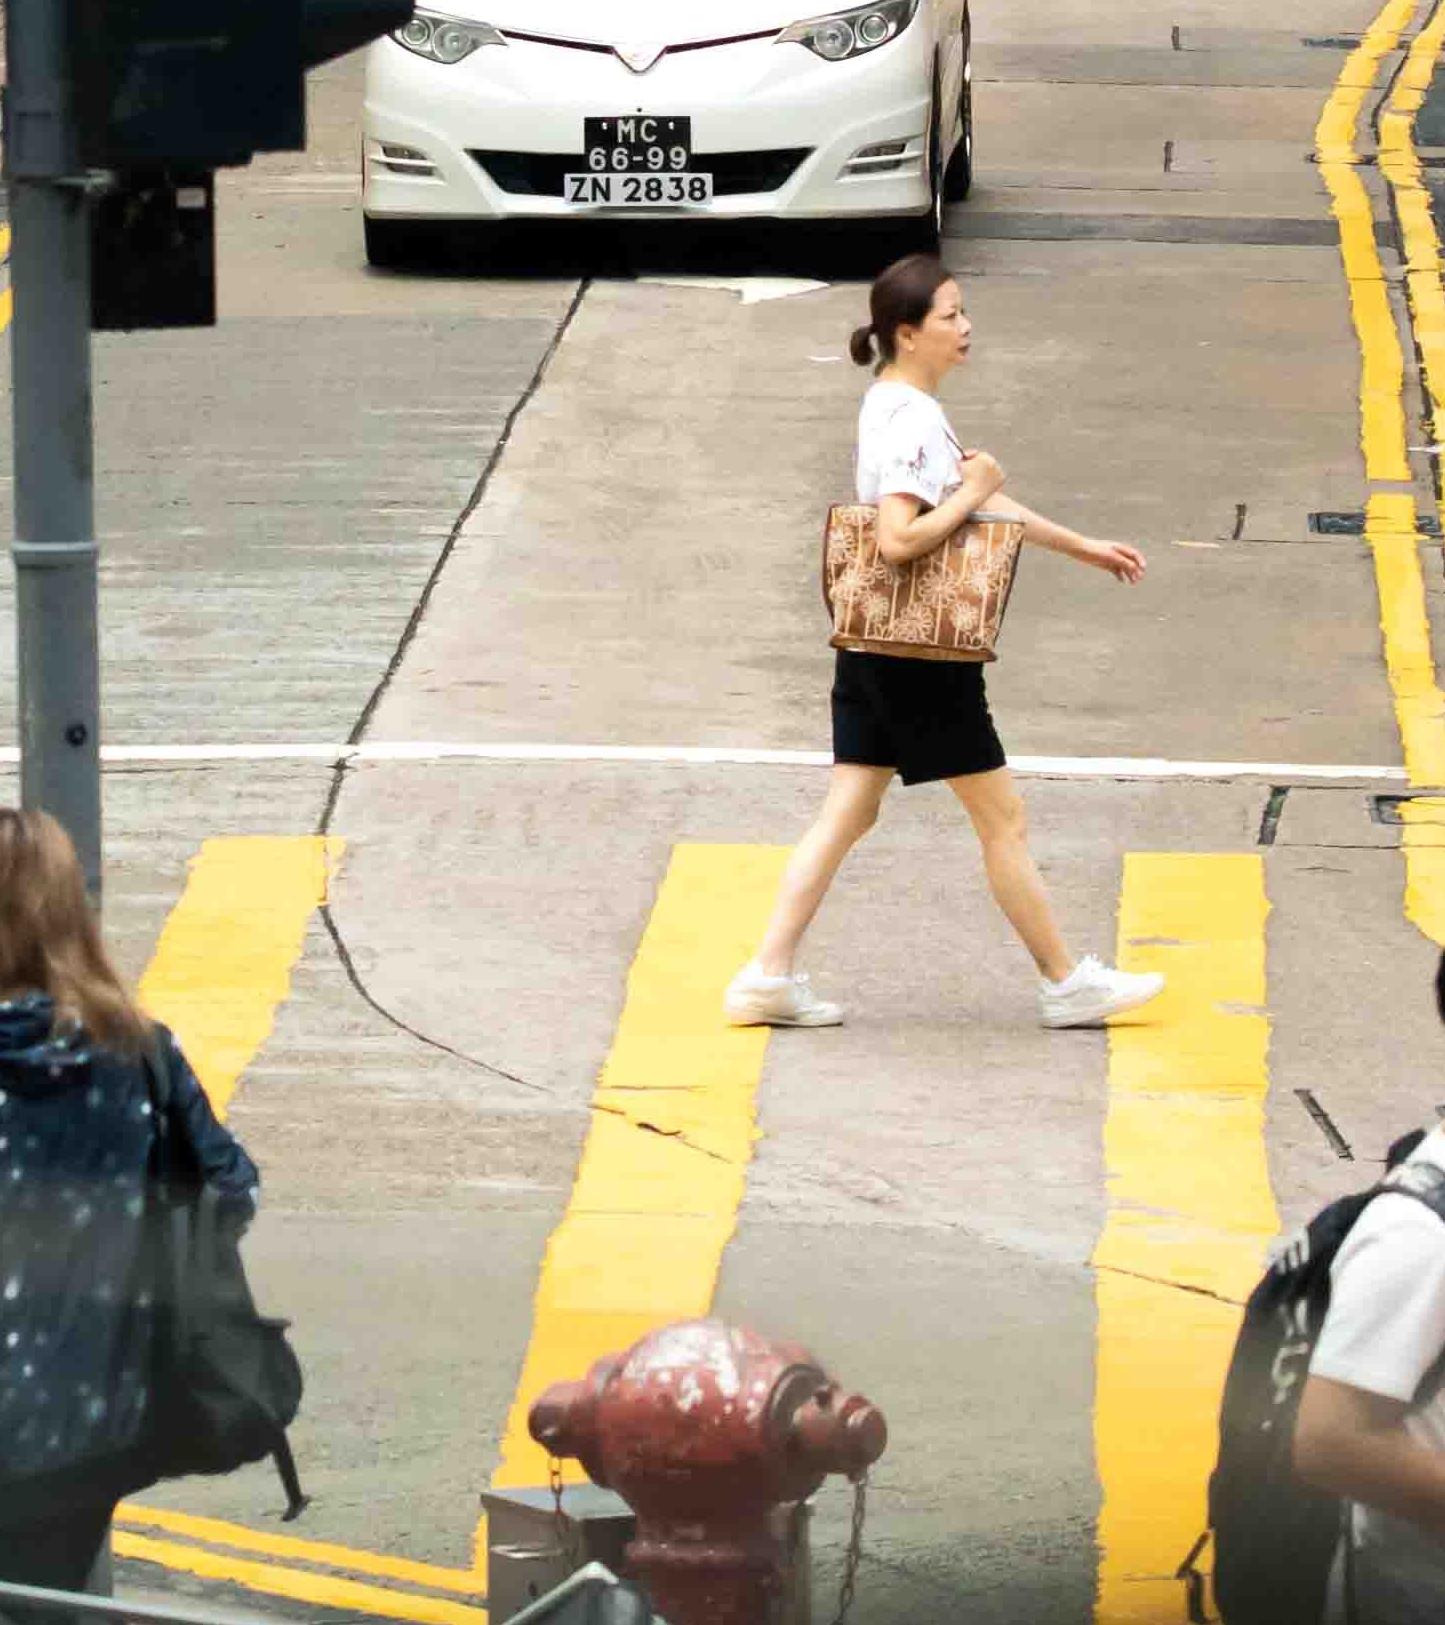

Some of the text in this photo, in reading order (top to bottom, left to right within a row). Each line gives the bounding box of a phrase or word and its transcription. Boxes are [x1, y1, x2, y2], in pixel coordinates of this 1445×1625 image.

[616, 118, 658, 144] MC
[588, 145, 688, 171] 66-99
[569, 176, 708, 203] ZN 2838
